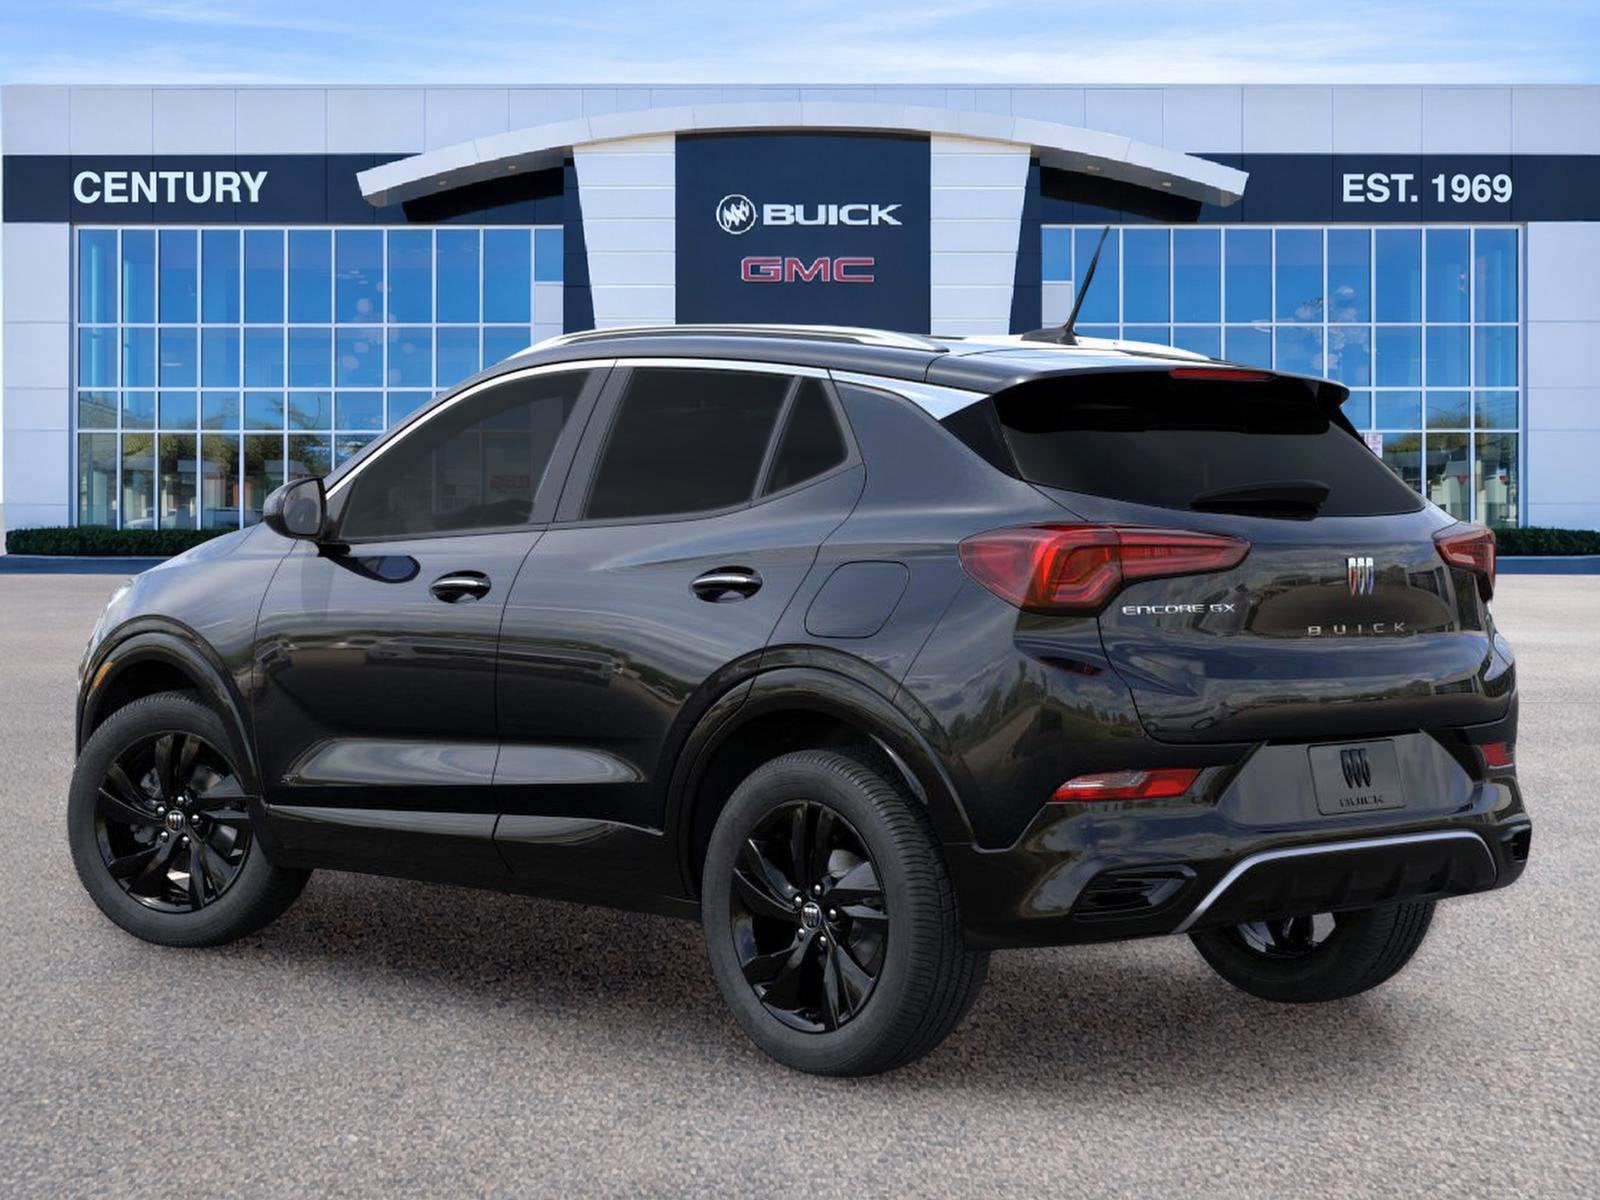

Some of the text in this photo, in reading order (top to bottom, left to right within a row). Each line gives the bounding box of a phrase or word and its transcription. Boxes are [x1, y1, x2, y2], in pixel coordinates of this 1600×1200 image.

[73, 170, 268, 204] CENTURY
[1342, 172, 1513, 203] EST. 1969
[763, 204, 903, 226] BUICK
[741, 256, 875, 283] GMC
[1122, 603, 1236, 616] ENCORE GX
[1308, 622, 1409, 637] BUICK
